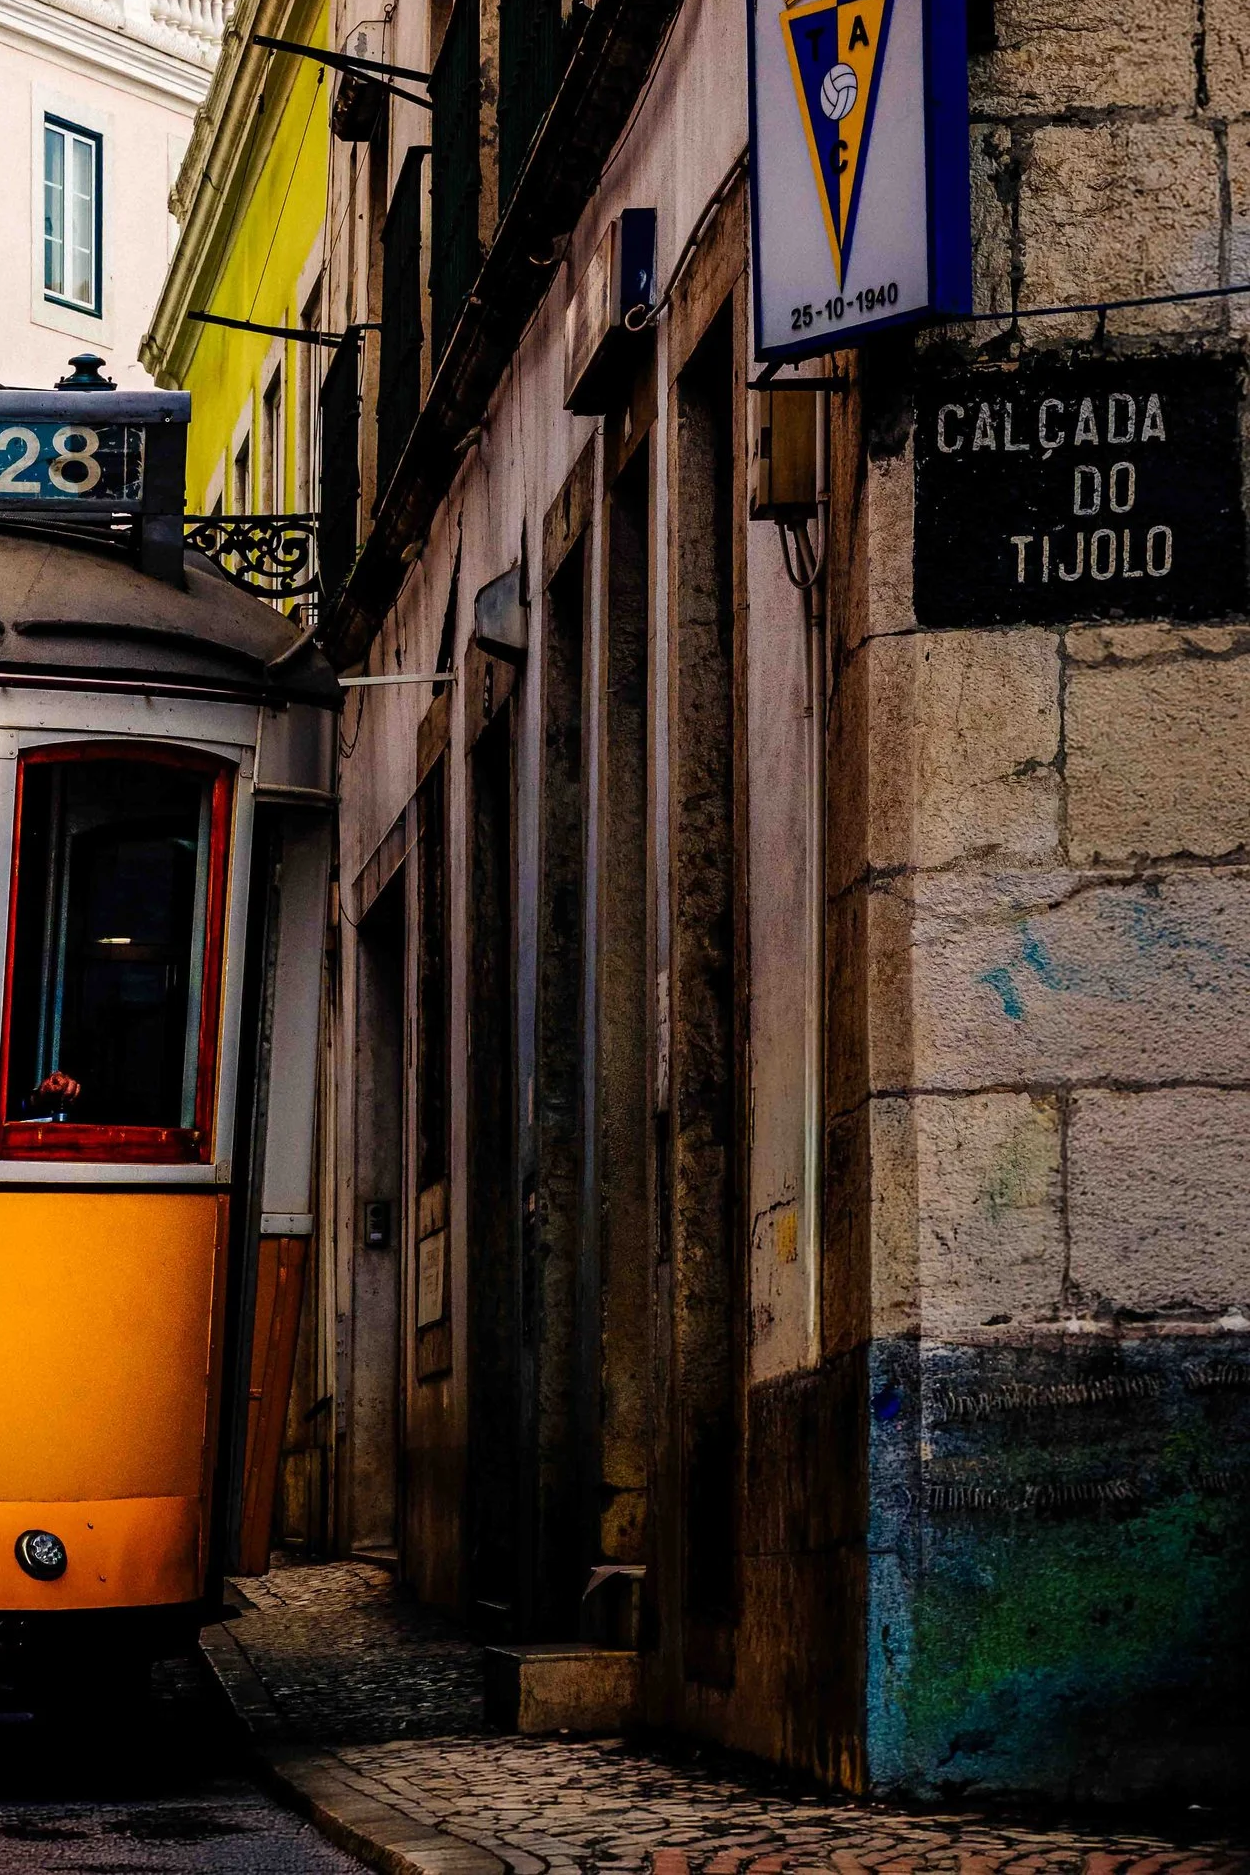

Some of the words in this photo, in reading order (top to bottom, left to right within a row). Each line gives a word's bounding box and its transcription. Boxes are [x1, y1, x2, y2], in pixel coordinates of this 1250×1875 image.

[805, 27, 825, 62] T
[848, 15, 870, 52] A
[829, 139, 849, 175] C
[791, 281, 899, 331] 25-10-1940
[937, 392, 1166, 460] CALÇADA
[1073, 461, 1136, 516] DO
[1010, 525, 1173, 583] TIJOLO
